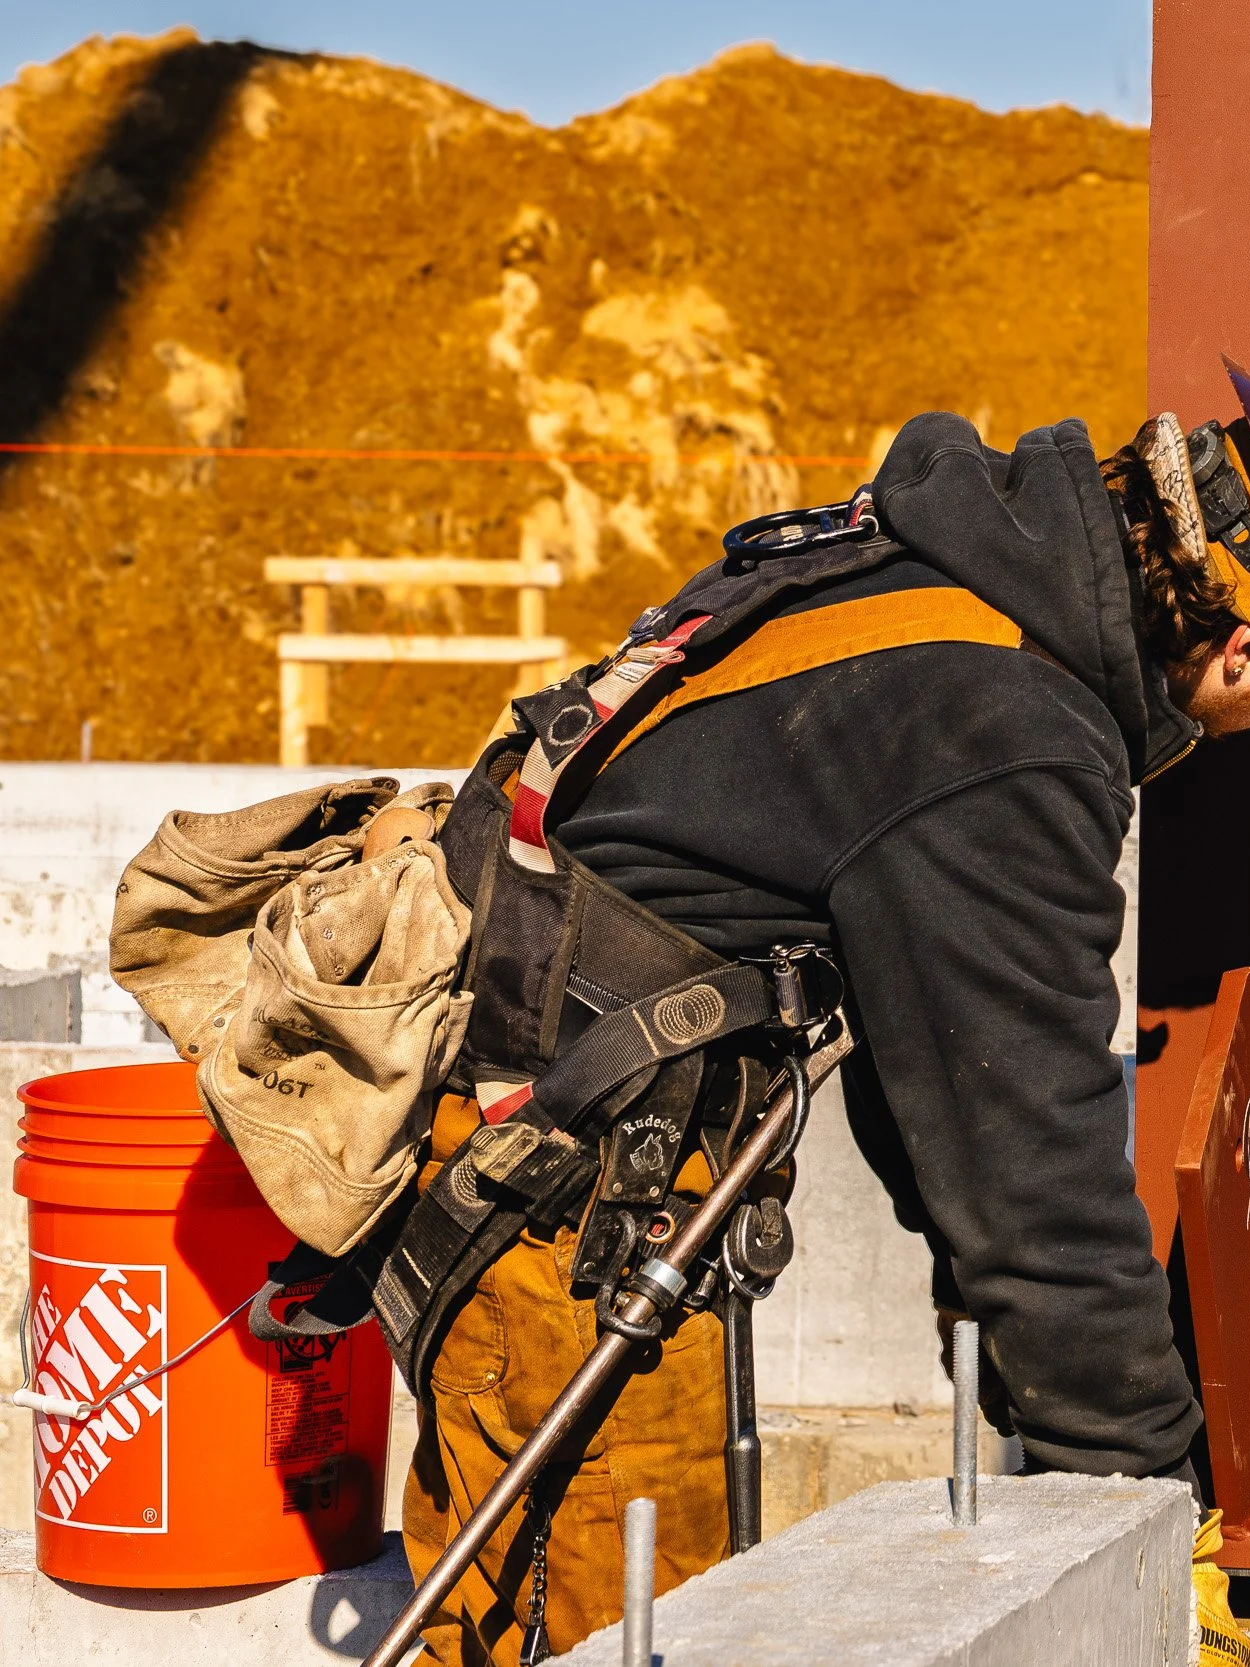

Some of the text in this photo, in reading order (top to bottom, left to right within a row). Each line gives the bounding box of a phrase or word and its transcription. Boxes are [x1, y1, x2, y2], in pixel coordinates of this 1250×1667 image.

[622, 1113, 681, 1143] Rudedog
[32, 1283, 62, 1373] HE
[49, 1364, 162, 1521] DEPOT
